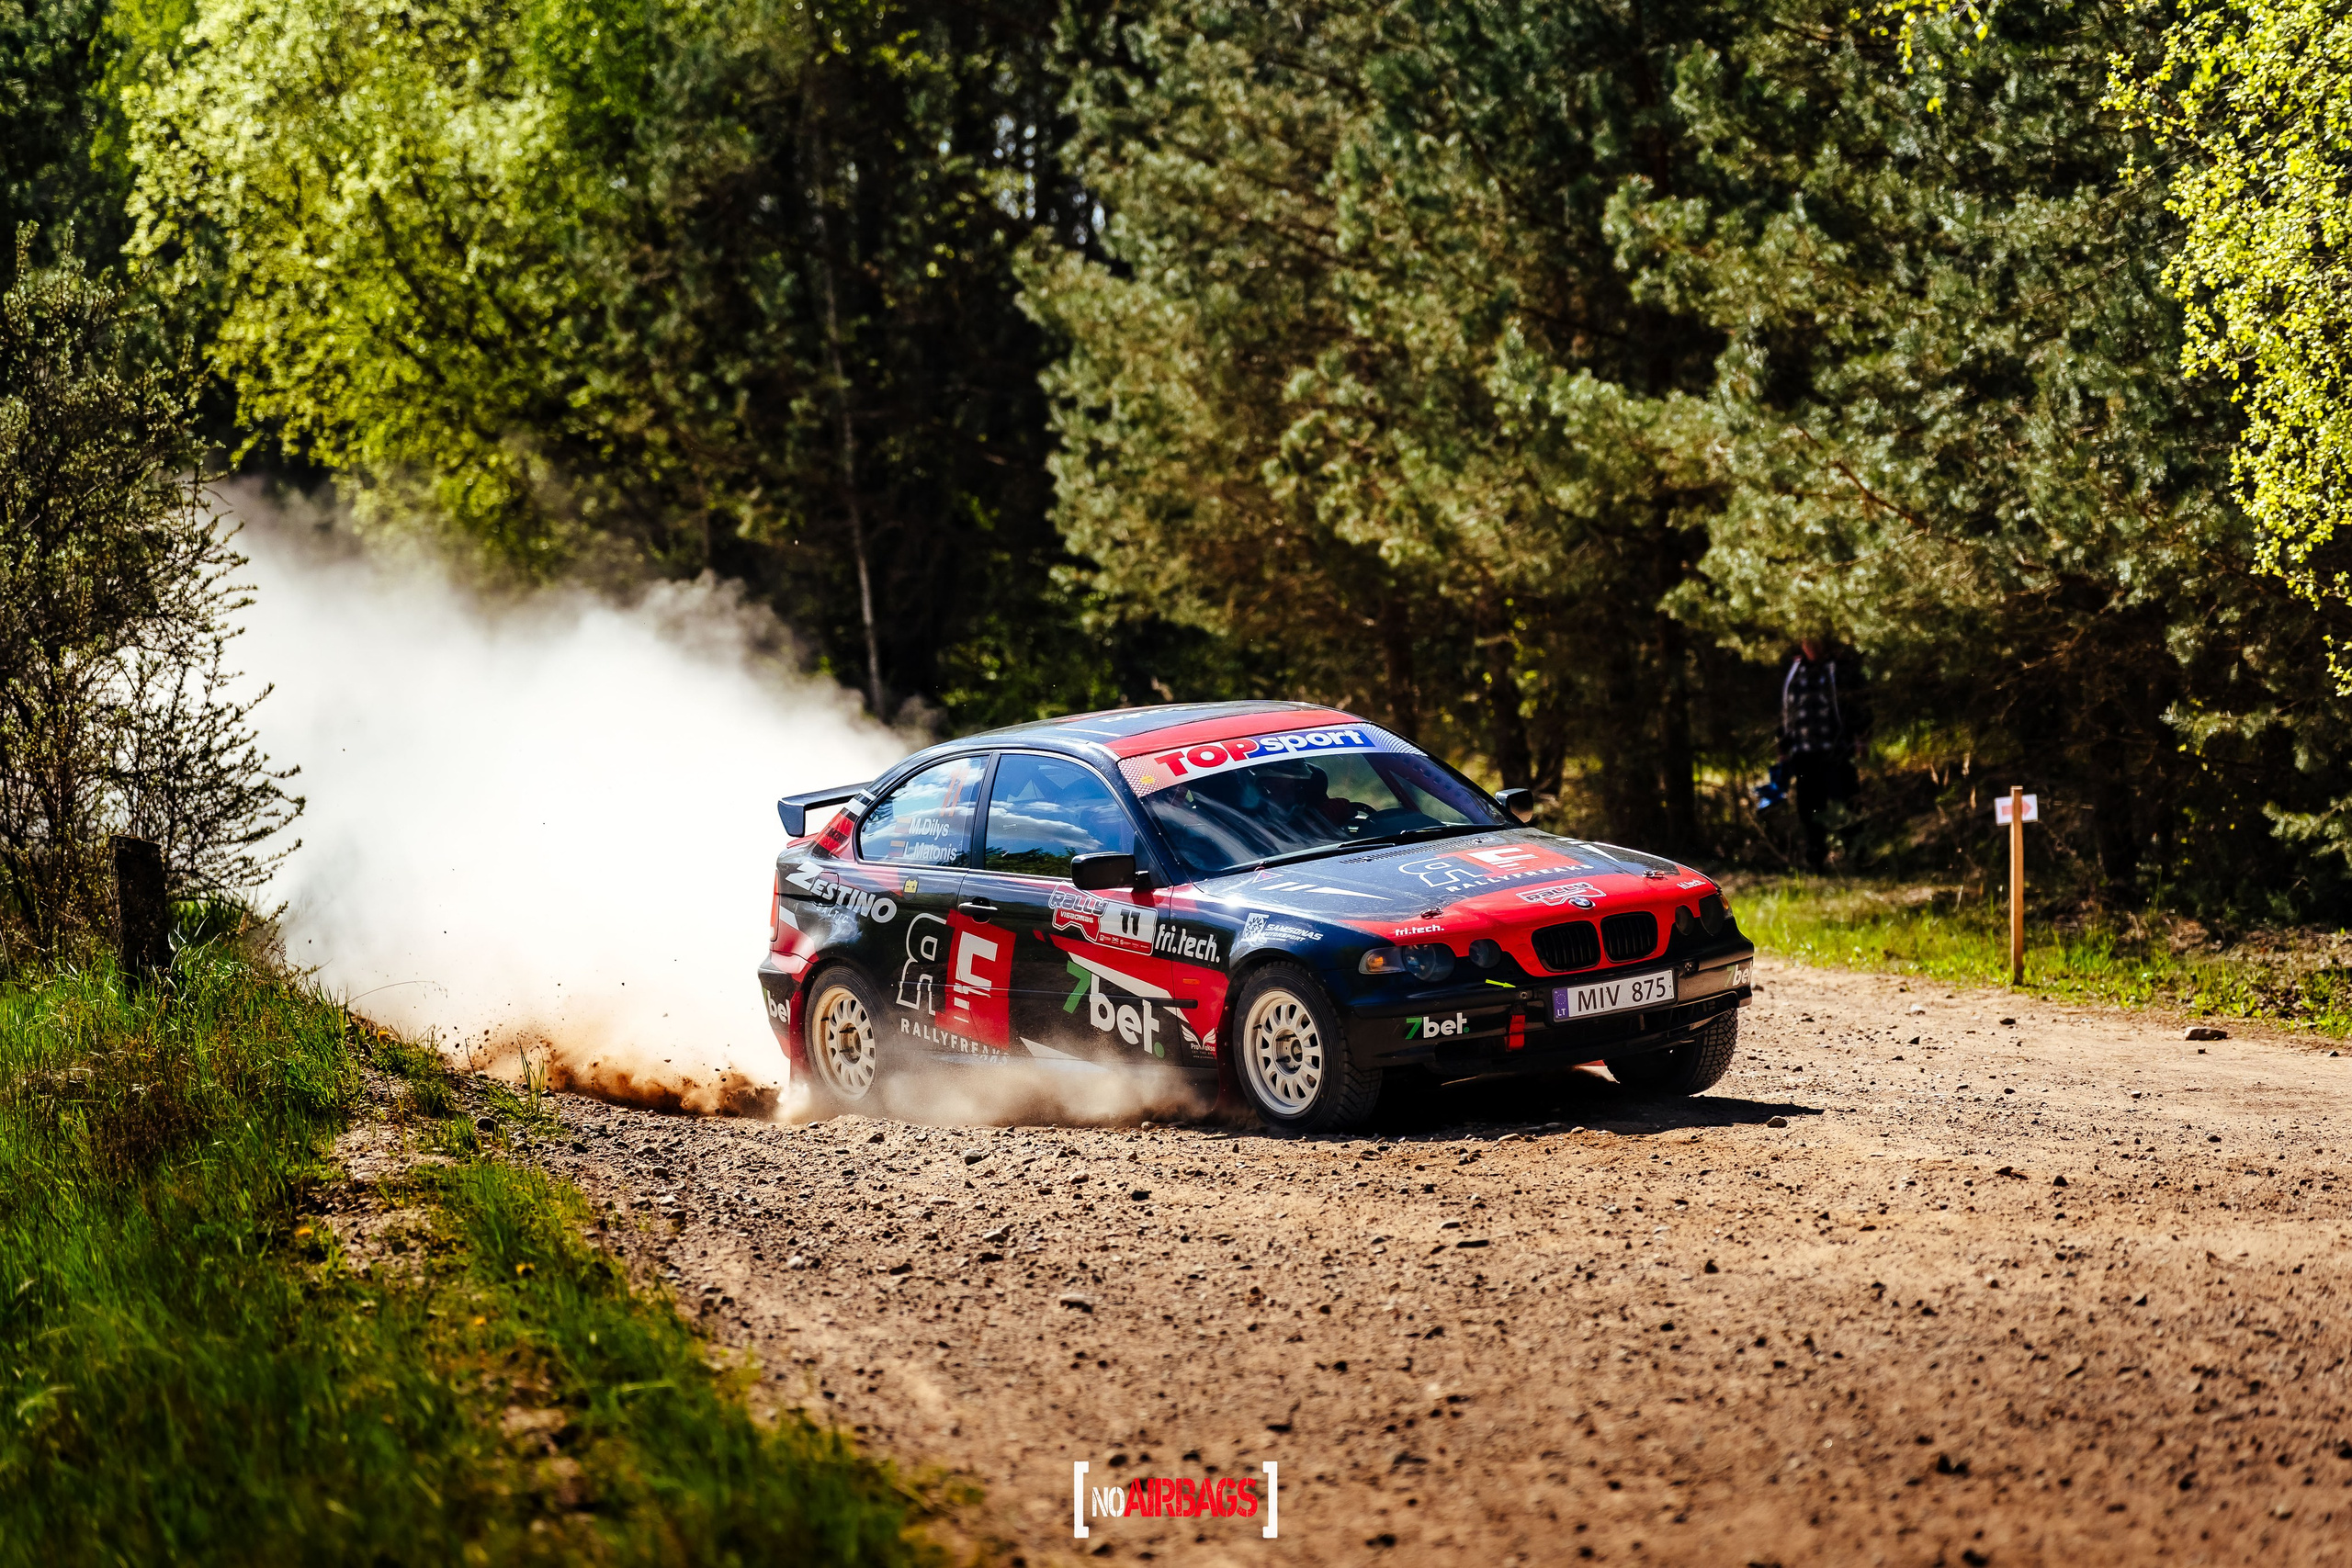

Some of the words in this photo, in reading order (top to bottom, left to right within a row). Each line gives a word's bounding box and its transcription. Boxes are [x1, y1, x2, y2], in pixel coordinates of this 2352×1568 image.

[939, 764, 971, 817] 11
[909, 818, 950, 840] M.Dilys
[903, 841, 957, 861] L.Matonis
[1445, 864, 1595, 892] RALLYFREAKS
[786, 861, 898, 923] ZESTINO
[816, 902, 849, 924] BALTIC
[1120, 908, 1141, 936] 11
[1261, 931, 1306, 942] MOTORSPORT
[1264, 923, 1324, 941] SAMSONAS
[1395, 924, 1445, 936] fri.tech.
[1154, 922, 1221, 964] fri.tech.
[1577, 985, 1621, 1012] MIV
[1631, 976, 1666, 1003] 875
[1556, 1007, 1566, 1017] LT
